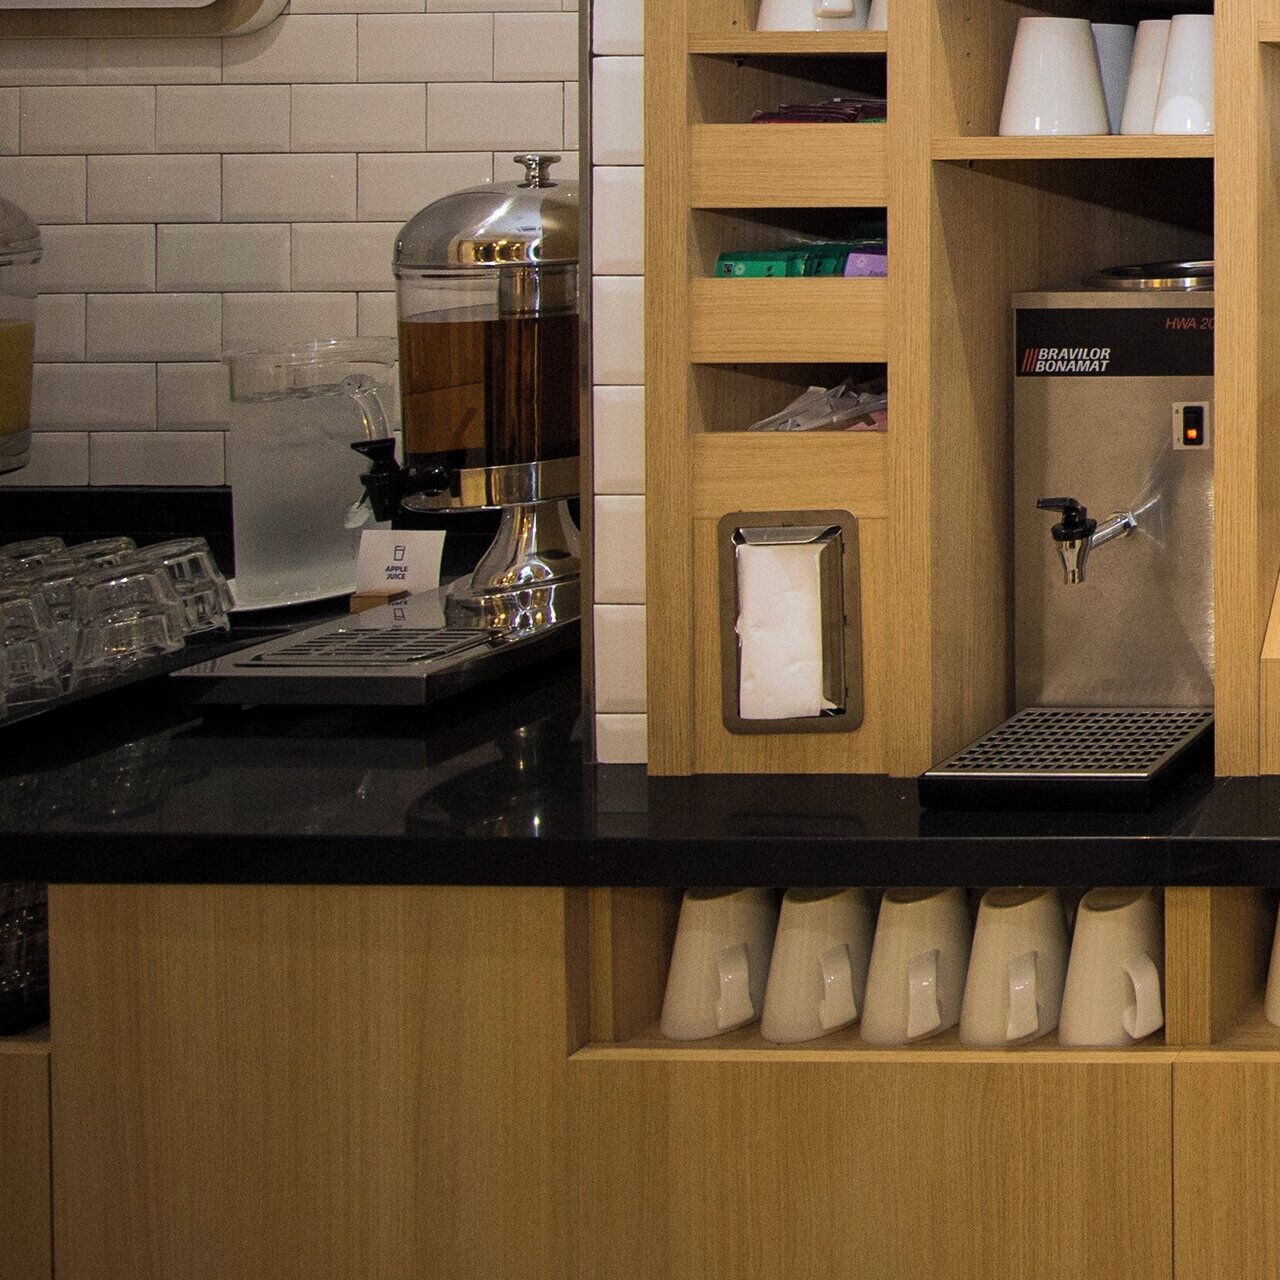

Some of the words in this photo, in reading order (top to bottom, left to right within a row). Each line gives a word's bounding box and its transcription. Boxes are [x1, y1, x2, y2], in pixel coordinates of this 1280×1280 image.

[1165, 317, 1197, 329] HWA
[1038, 348, 1111, 360] BRAVILOR
[1035, 360, 1109, 372] BONAMAT
